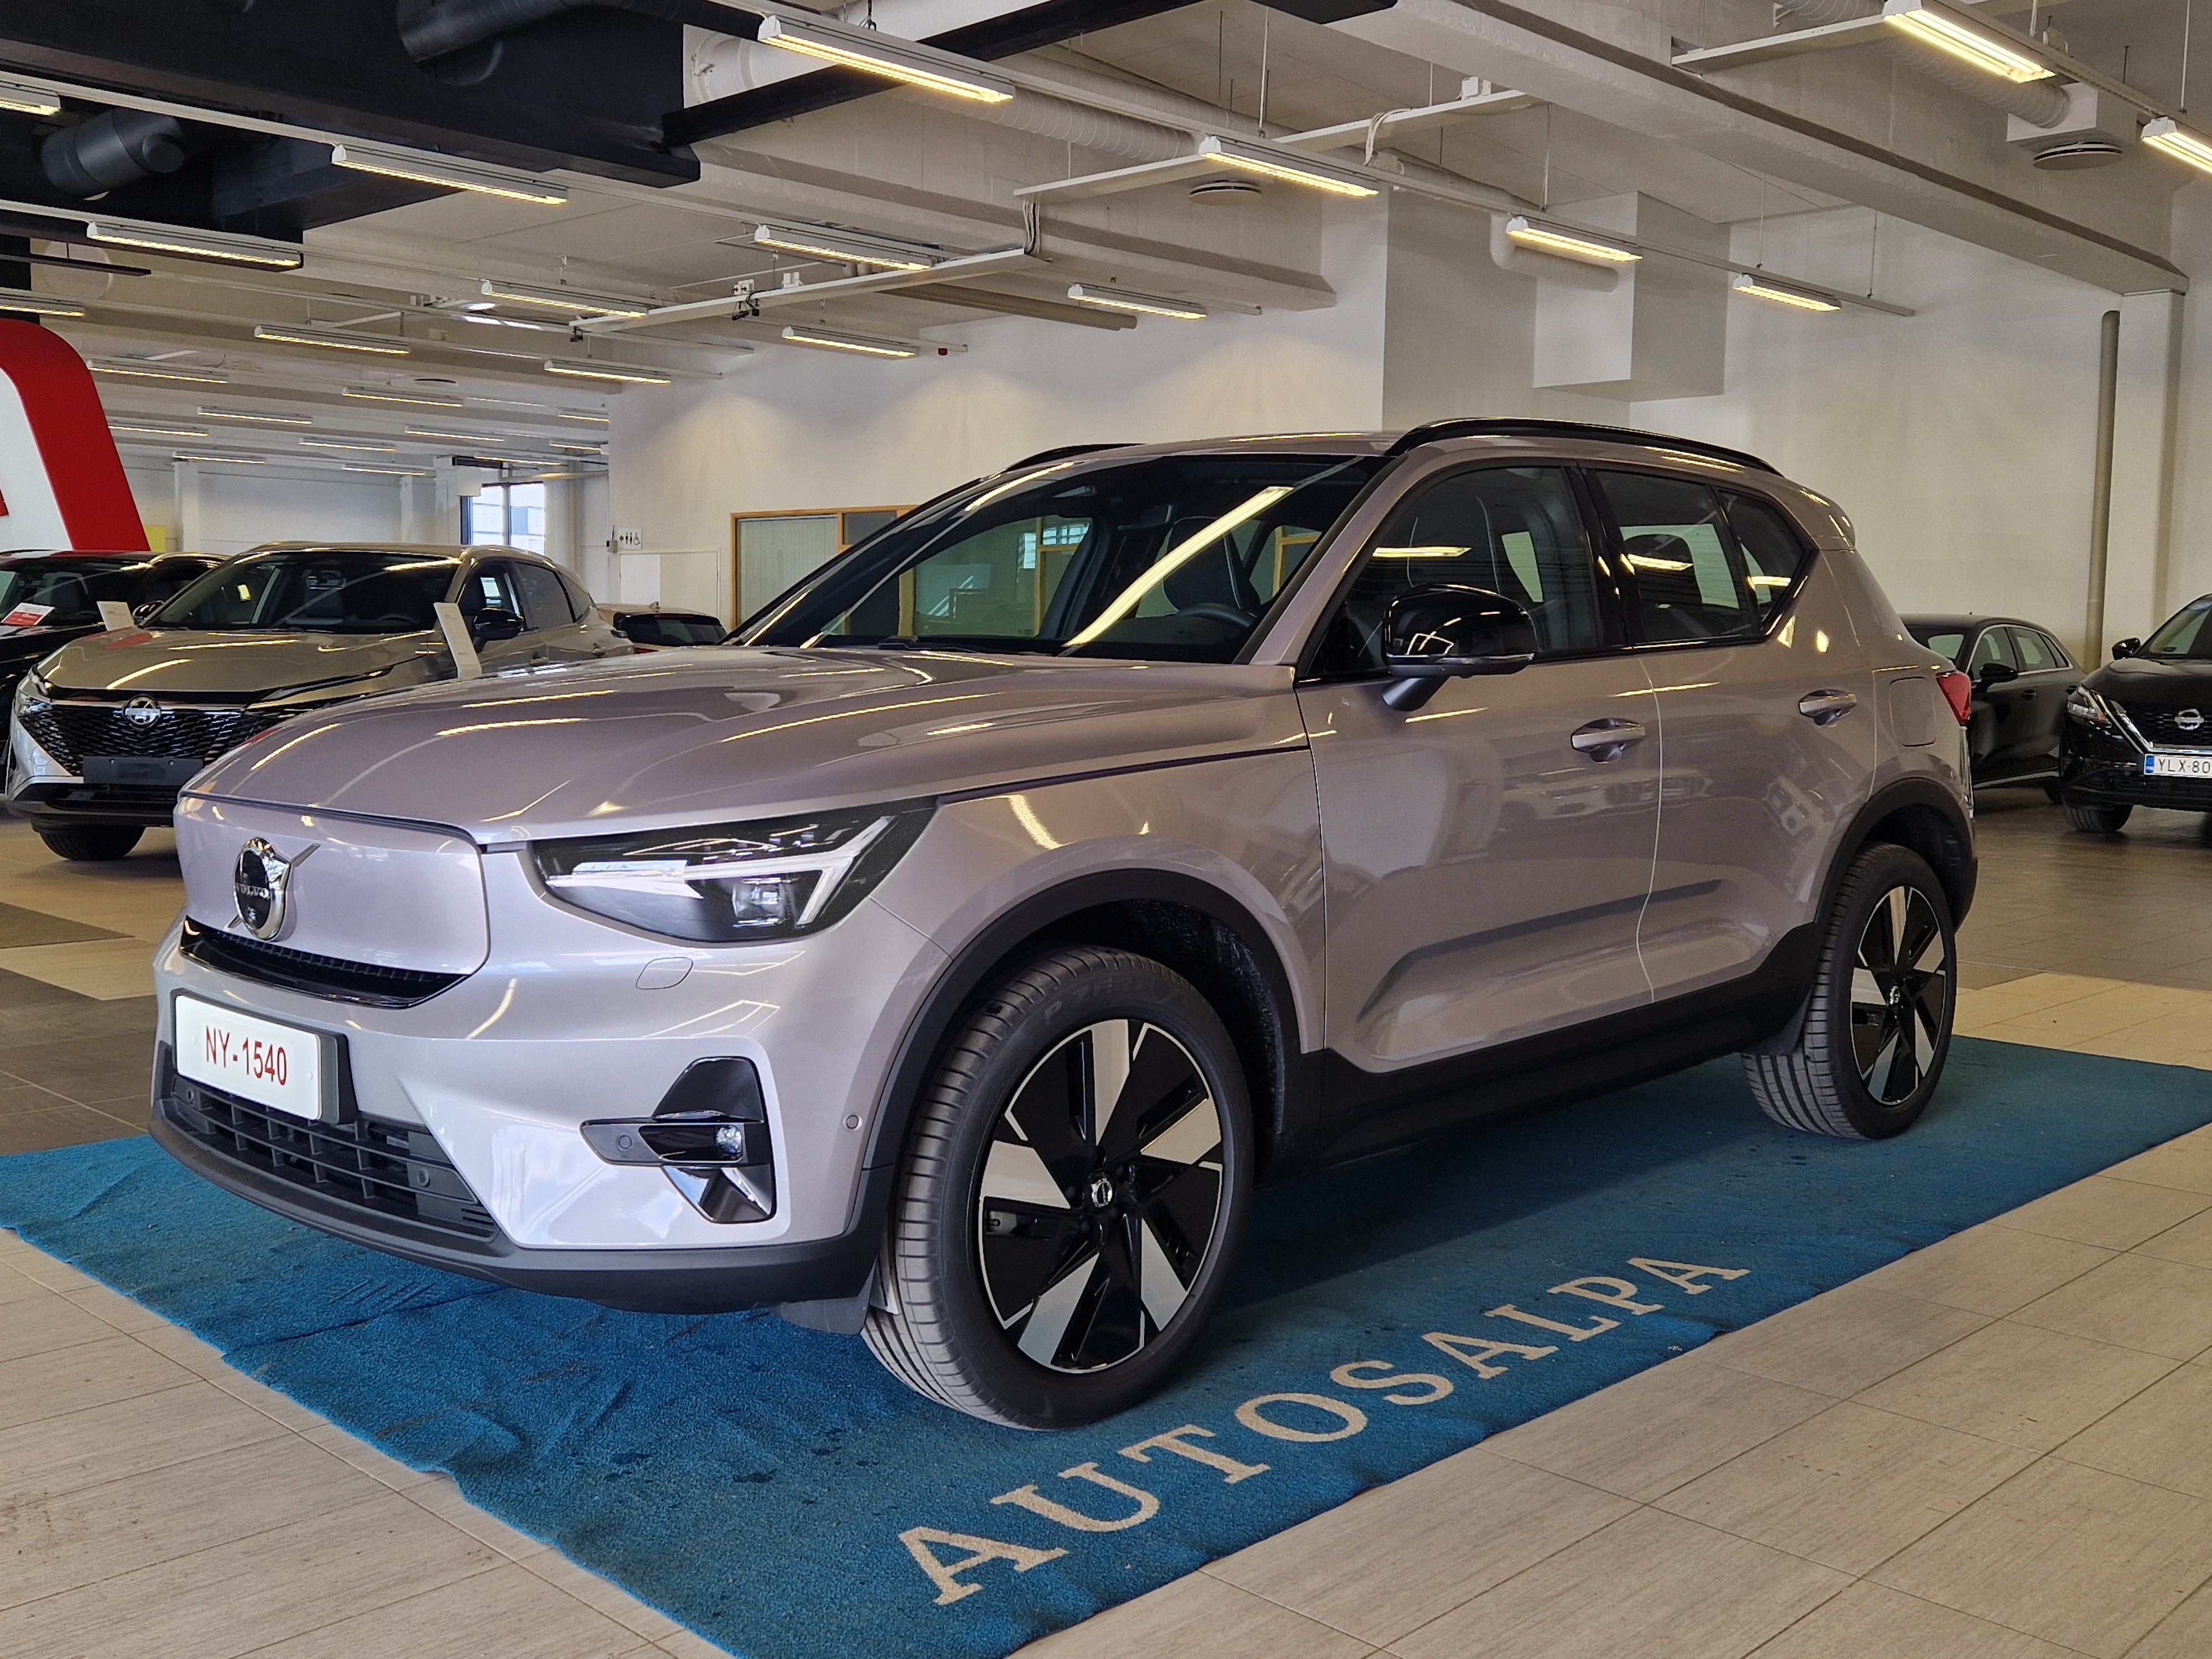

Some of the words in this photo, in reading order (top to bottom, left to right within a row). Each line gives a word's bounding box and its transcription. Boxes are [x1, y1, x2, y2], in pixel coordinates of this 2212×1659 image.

[236, 883, 270, 900] VOLVO
[206, 1025, 287, 1086] NY-1540
[898, 1255, 1751, 1606] AUTOSALPA
